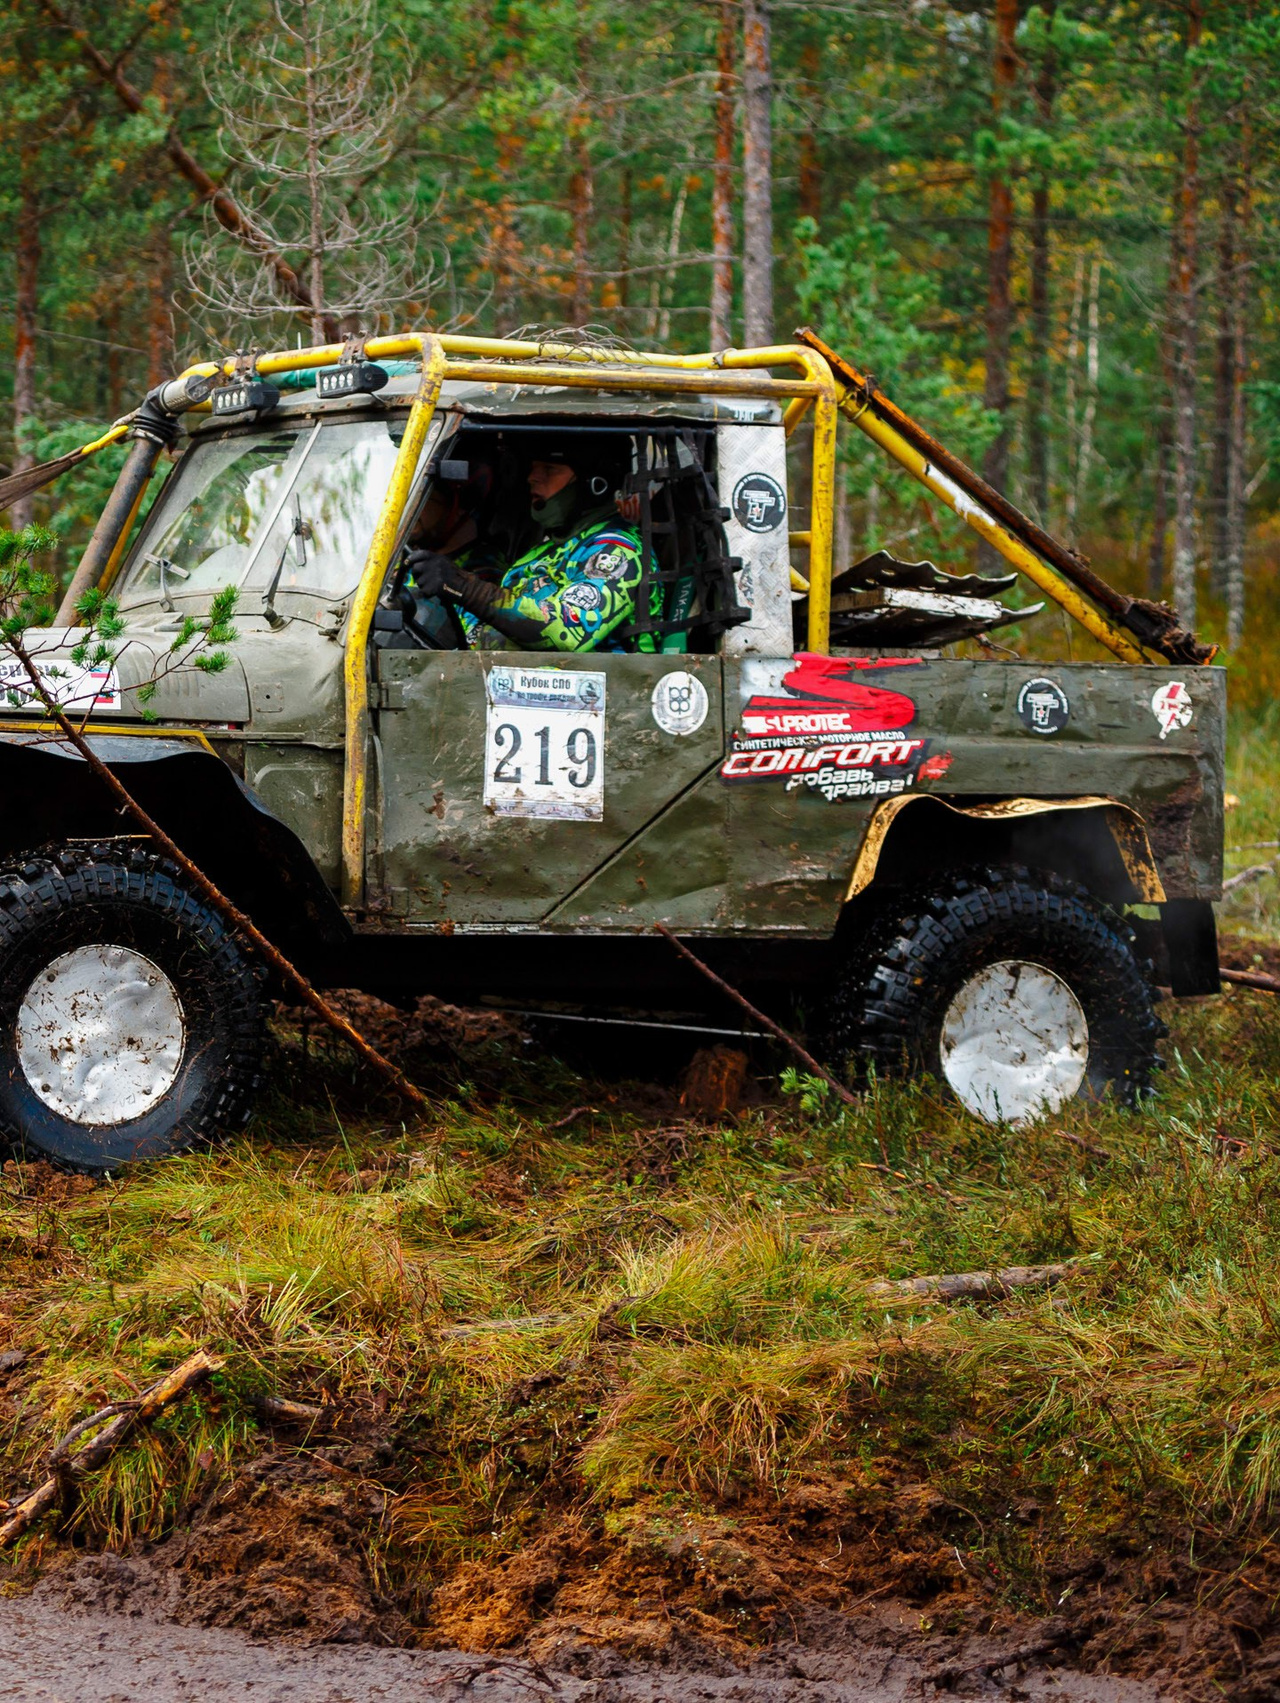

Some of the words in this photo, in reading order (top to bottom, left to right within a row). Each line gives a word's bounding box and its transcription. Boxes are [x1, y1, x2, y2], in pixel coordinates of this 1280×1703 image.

[520, 676, 549, 688] Кубок
[552, 678, 571, 689] СПб
[819, 733, 871, 745] МОТОРНОЕ
[873, 731, 906, 741] МАСЛО
[493, 723, 597, 788] 219
[723, 740, 921, 775] COMFORT
